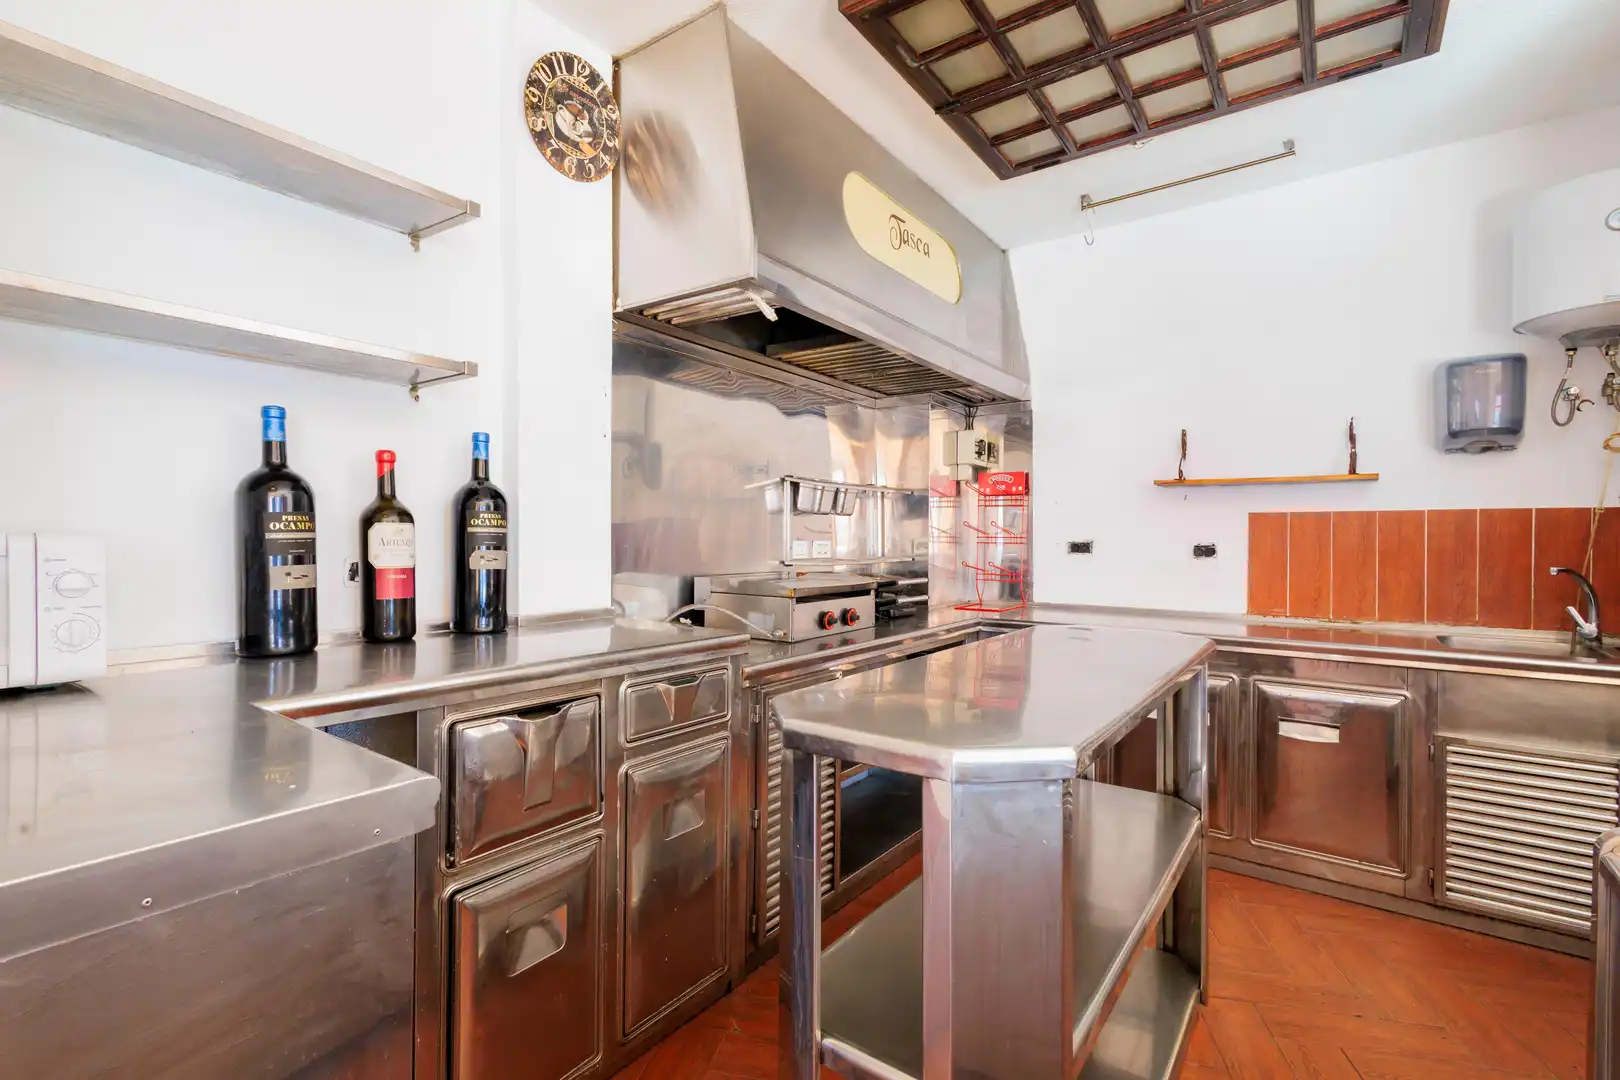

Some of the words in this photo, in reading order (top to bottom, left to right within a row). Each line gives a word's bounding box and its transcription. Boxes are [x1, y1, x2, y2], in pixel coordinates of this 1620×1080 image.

[551, 52, 568, 76] 11
[573, 58, 590, 83] 12
[535, 62, 552, 86] 10
[526, 88, 543, 105] 9
[593, 81, 607, 96] 1
[604, 105, 618, 121] 2
[530, 117, 546, 132] 8
[546, 139, 560, 160] 7
[564, 156, 577, 178] 6
[583, 159, 595, 179] 5
[599, 150, 611, 169] 4
[470, 518, 507, 527] OCAMPO
